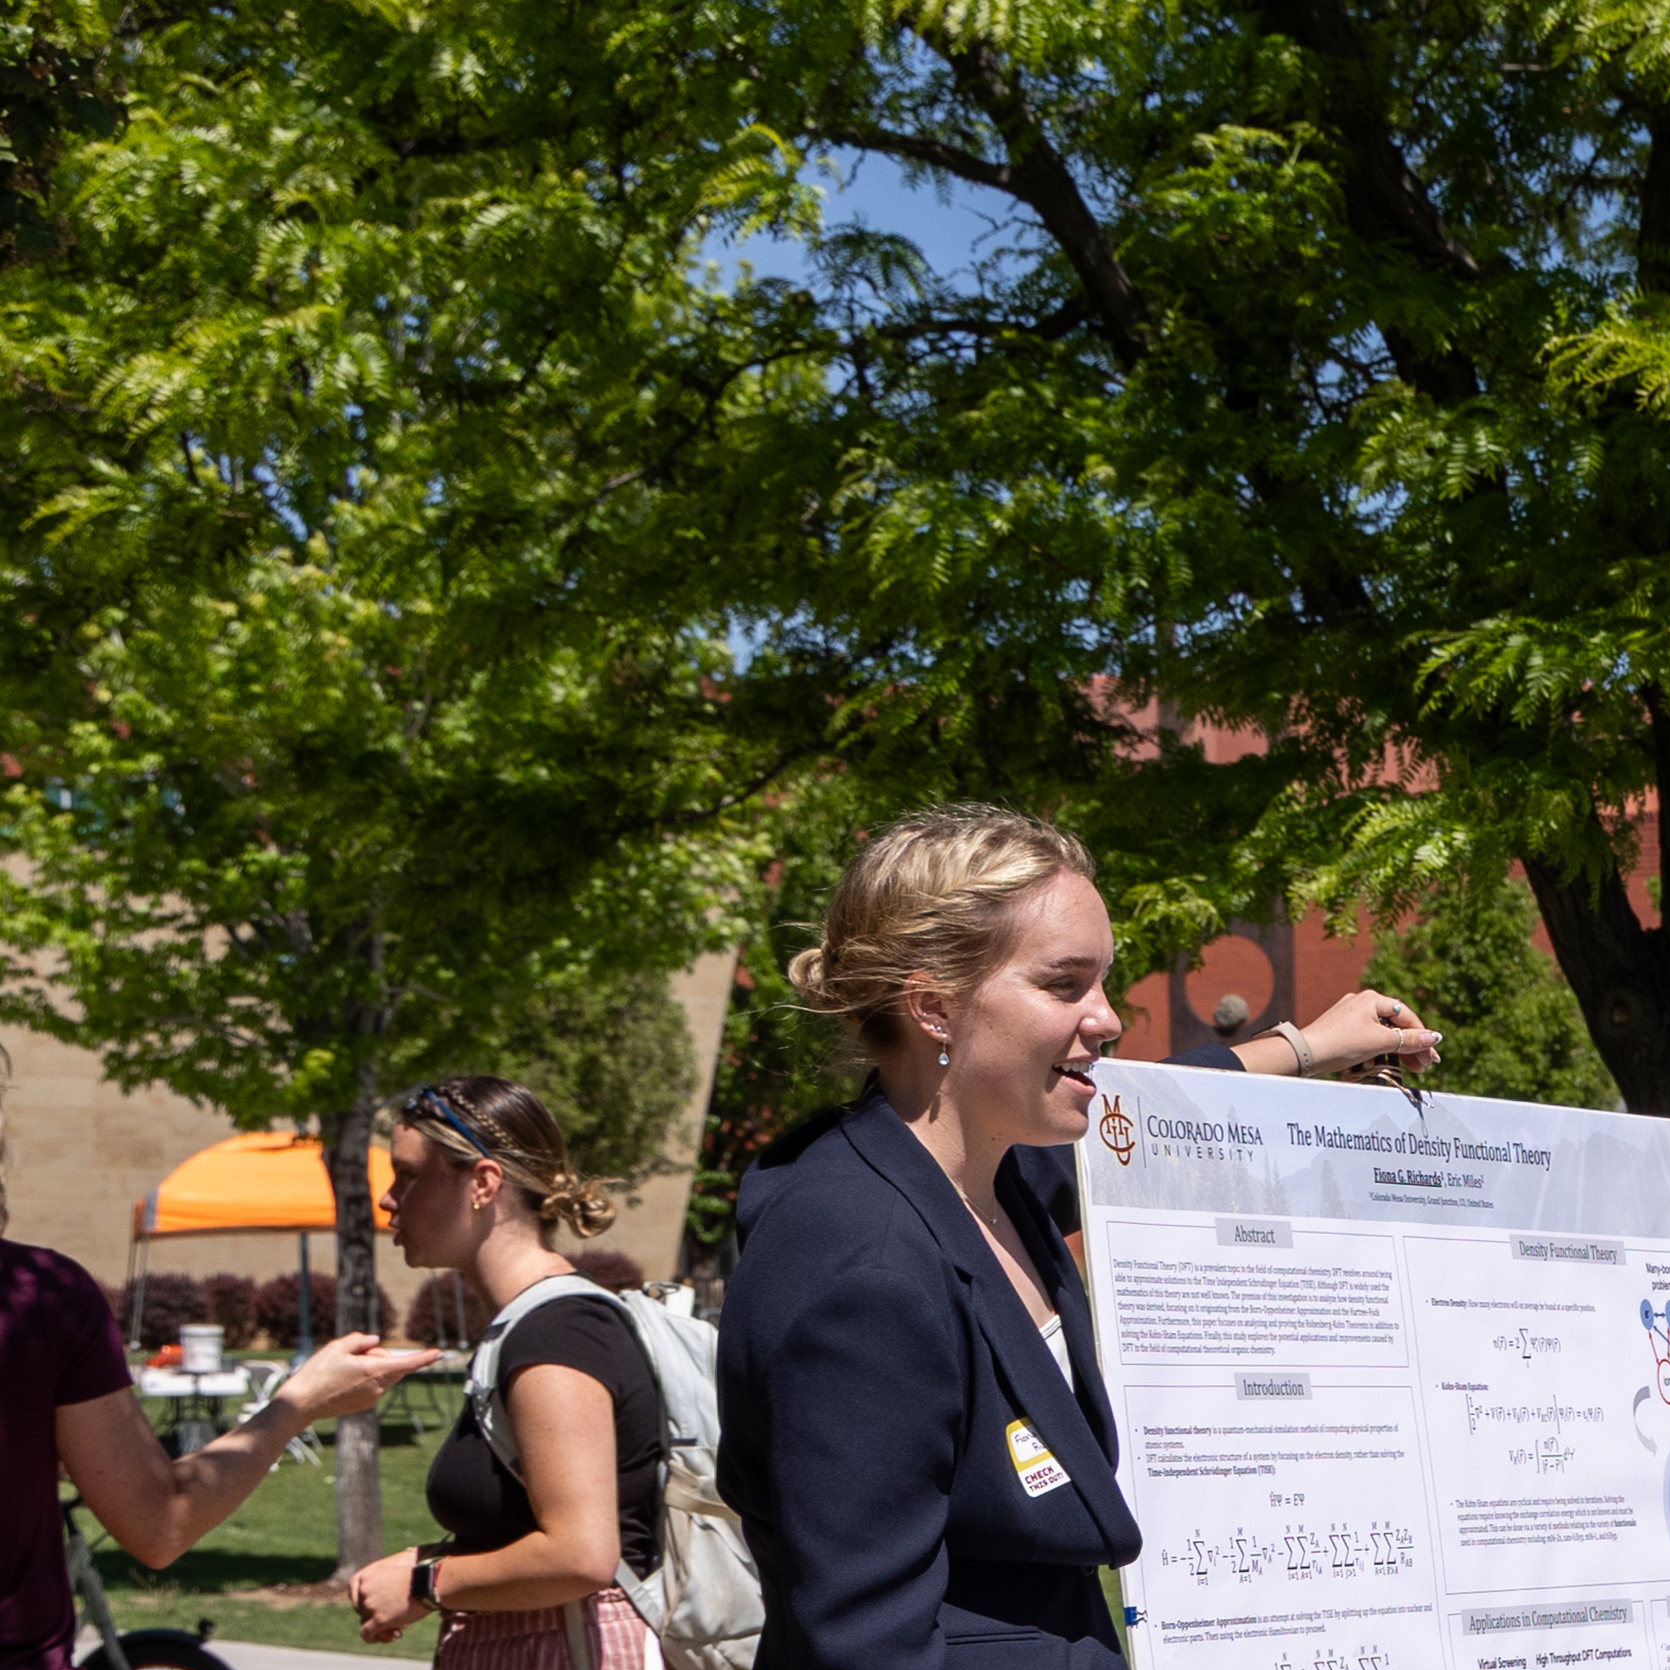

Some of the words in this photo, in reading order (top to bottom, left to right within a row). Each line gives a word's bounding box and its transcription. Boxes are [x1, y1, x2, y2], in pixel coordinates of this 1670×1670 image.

[1147, 1115, 1225, 1144] COLORADO
[1227, 1121, 1264, 1146] MESA
[1151, 1143, 1255, 1163] UNIVERSITY
[1286, 1122, 1312, 1147] The
[1314, 1124, 1394, 1154] Mathematics
[1394, 1131, 1408, 1155] of
[1408, 1132, 1452, 1164] Density
[1453, 1136, 1512, 1163] Functional
[1512, 1142, 1552, 1171] Theory
[1373, 1167, 1397, 1184] Fiona
[1397, 1169, 1406, 1184] G.
[1447, 1171, 1462, 1188] Eric
[1234, 1225, 1276, 1244] Abstract
[1519, 1240, 1549, 1262] Density
[1549, 1242, 1590, 1261] Functional
[1590, 1244, 1618, 1265] Theory
[1242, 1379, 1305, 1397] Introduction
[1024, 1465, 1055, 1485] CHECK
[1028, 1479, 1048, 1492] THIS
[1469, 1613, 1522, 1635] Applications
[1521, 1612, 1531, 1628] in
[1531, 1608, 1589, 1629] Computational
[1588, 1605, 1628, 1624] Chemistry
[1477, 1658, 1499, 1670] Virtual
[1498, 1656, 1528, 1670] Screening
[1535, 1653, 1549, 1668] High
[1549, 1651, 1582, 1667] Throughput
[1581, 1649, 1594, 1662] DFT
[1594, 1647, 1633, 1662] Computations
